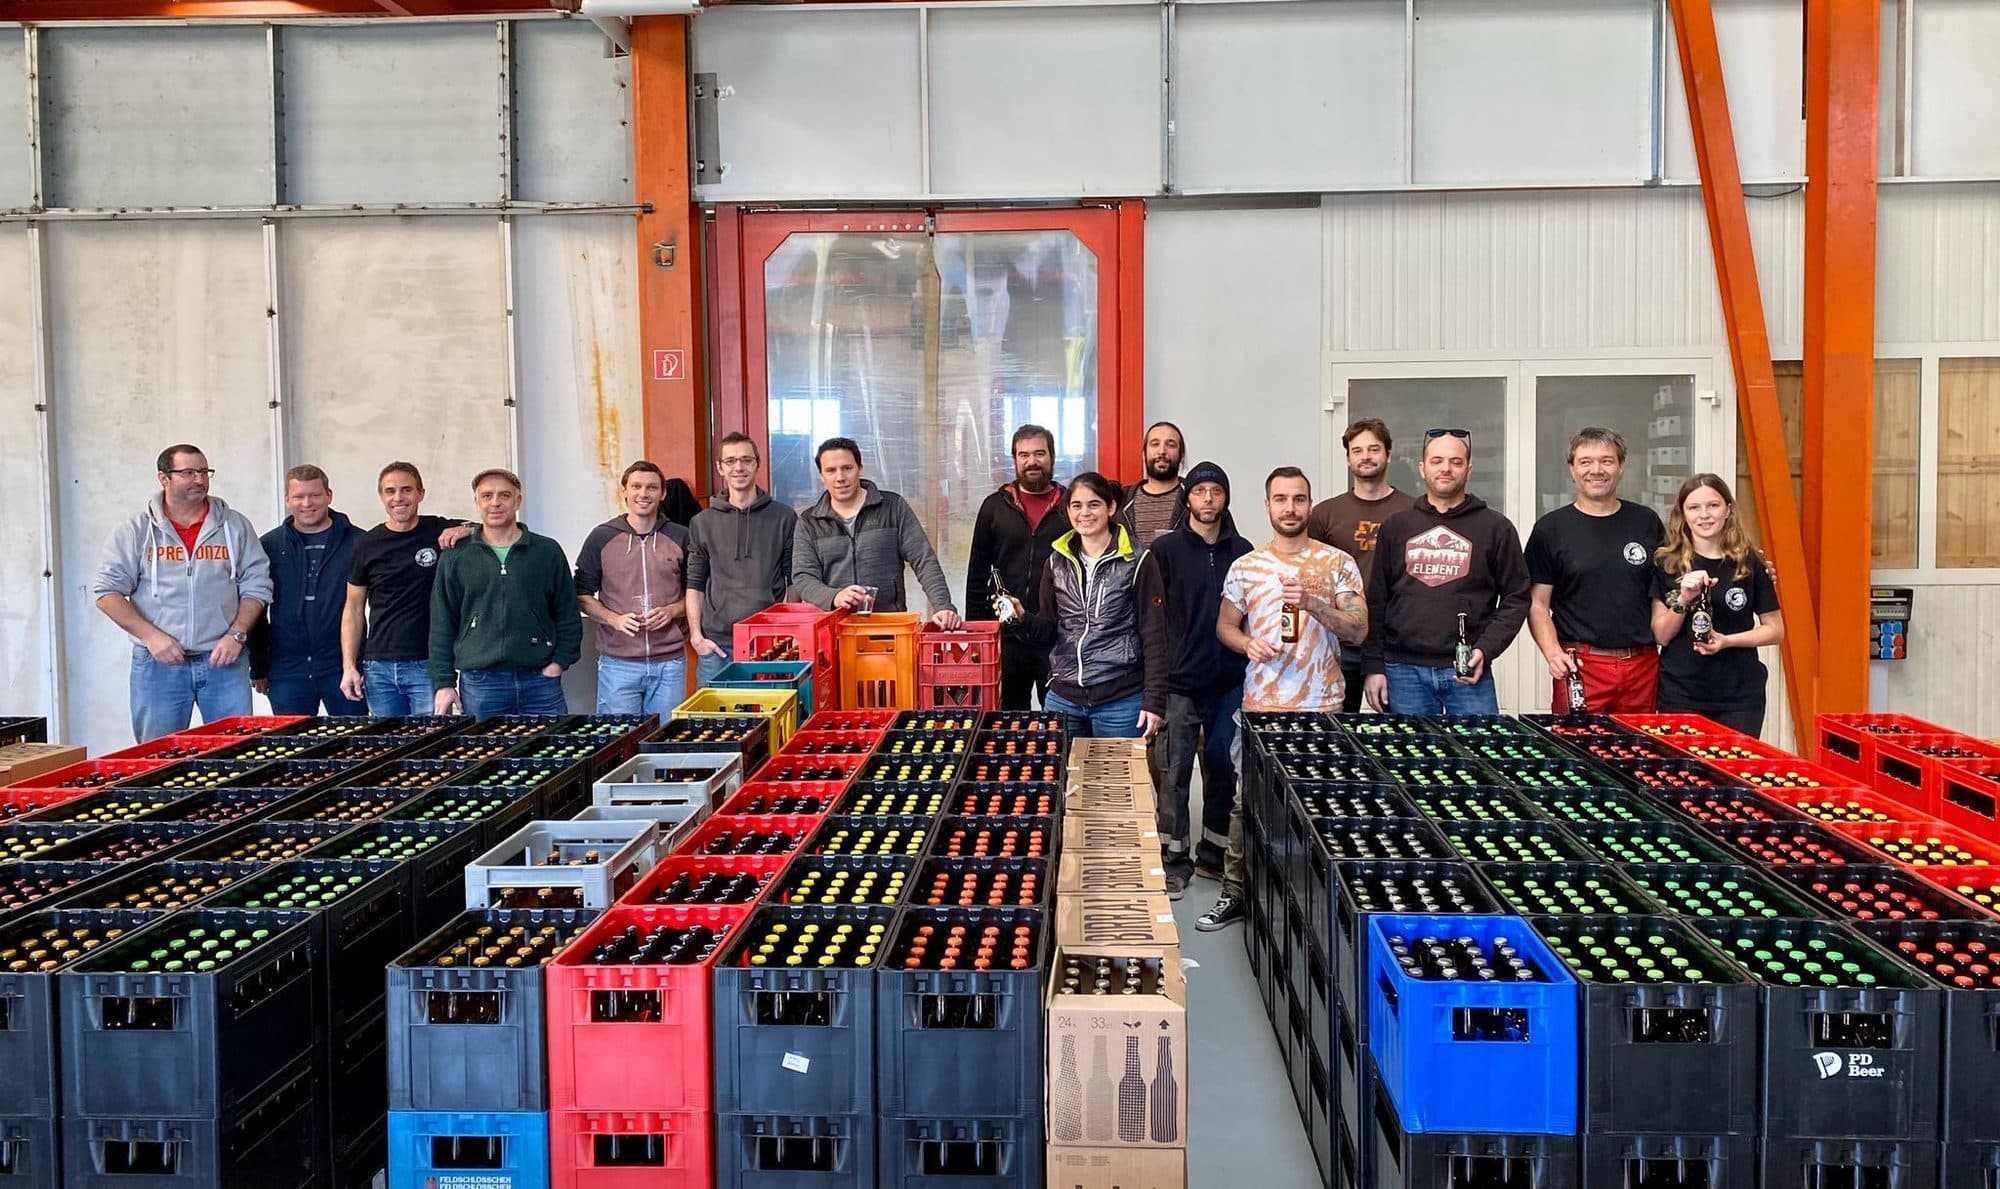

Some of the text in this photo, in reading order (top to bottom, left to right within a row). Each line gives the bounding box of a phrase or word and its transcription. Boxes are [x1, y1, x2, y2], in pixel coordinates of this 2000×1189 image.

[1413, 563, 1461, 575] ELEMENT
[1083, 899, 1154, 942] BIRRA!
[1848, 1053, 1873, 1065] PD
[1848, 1065, 1885, 1077] Beer
